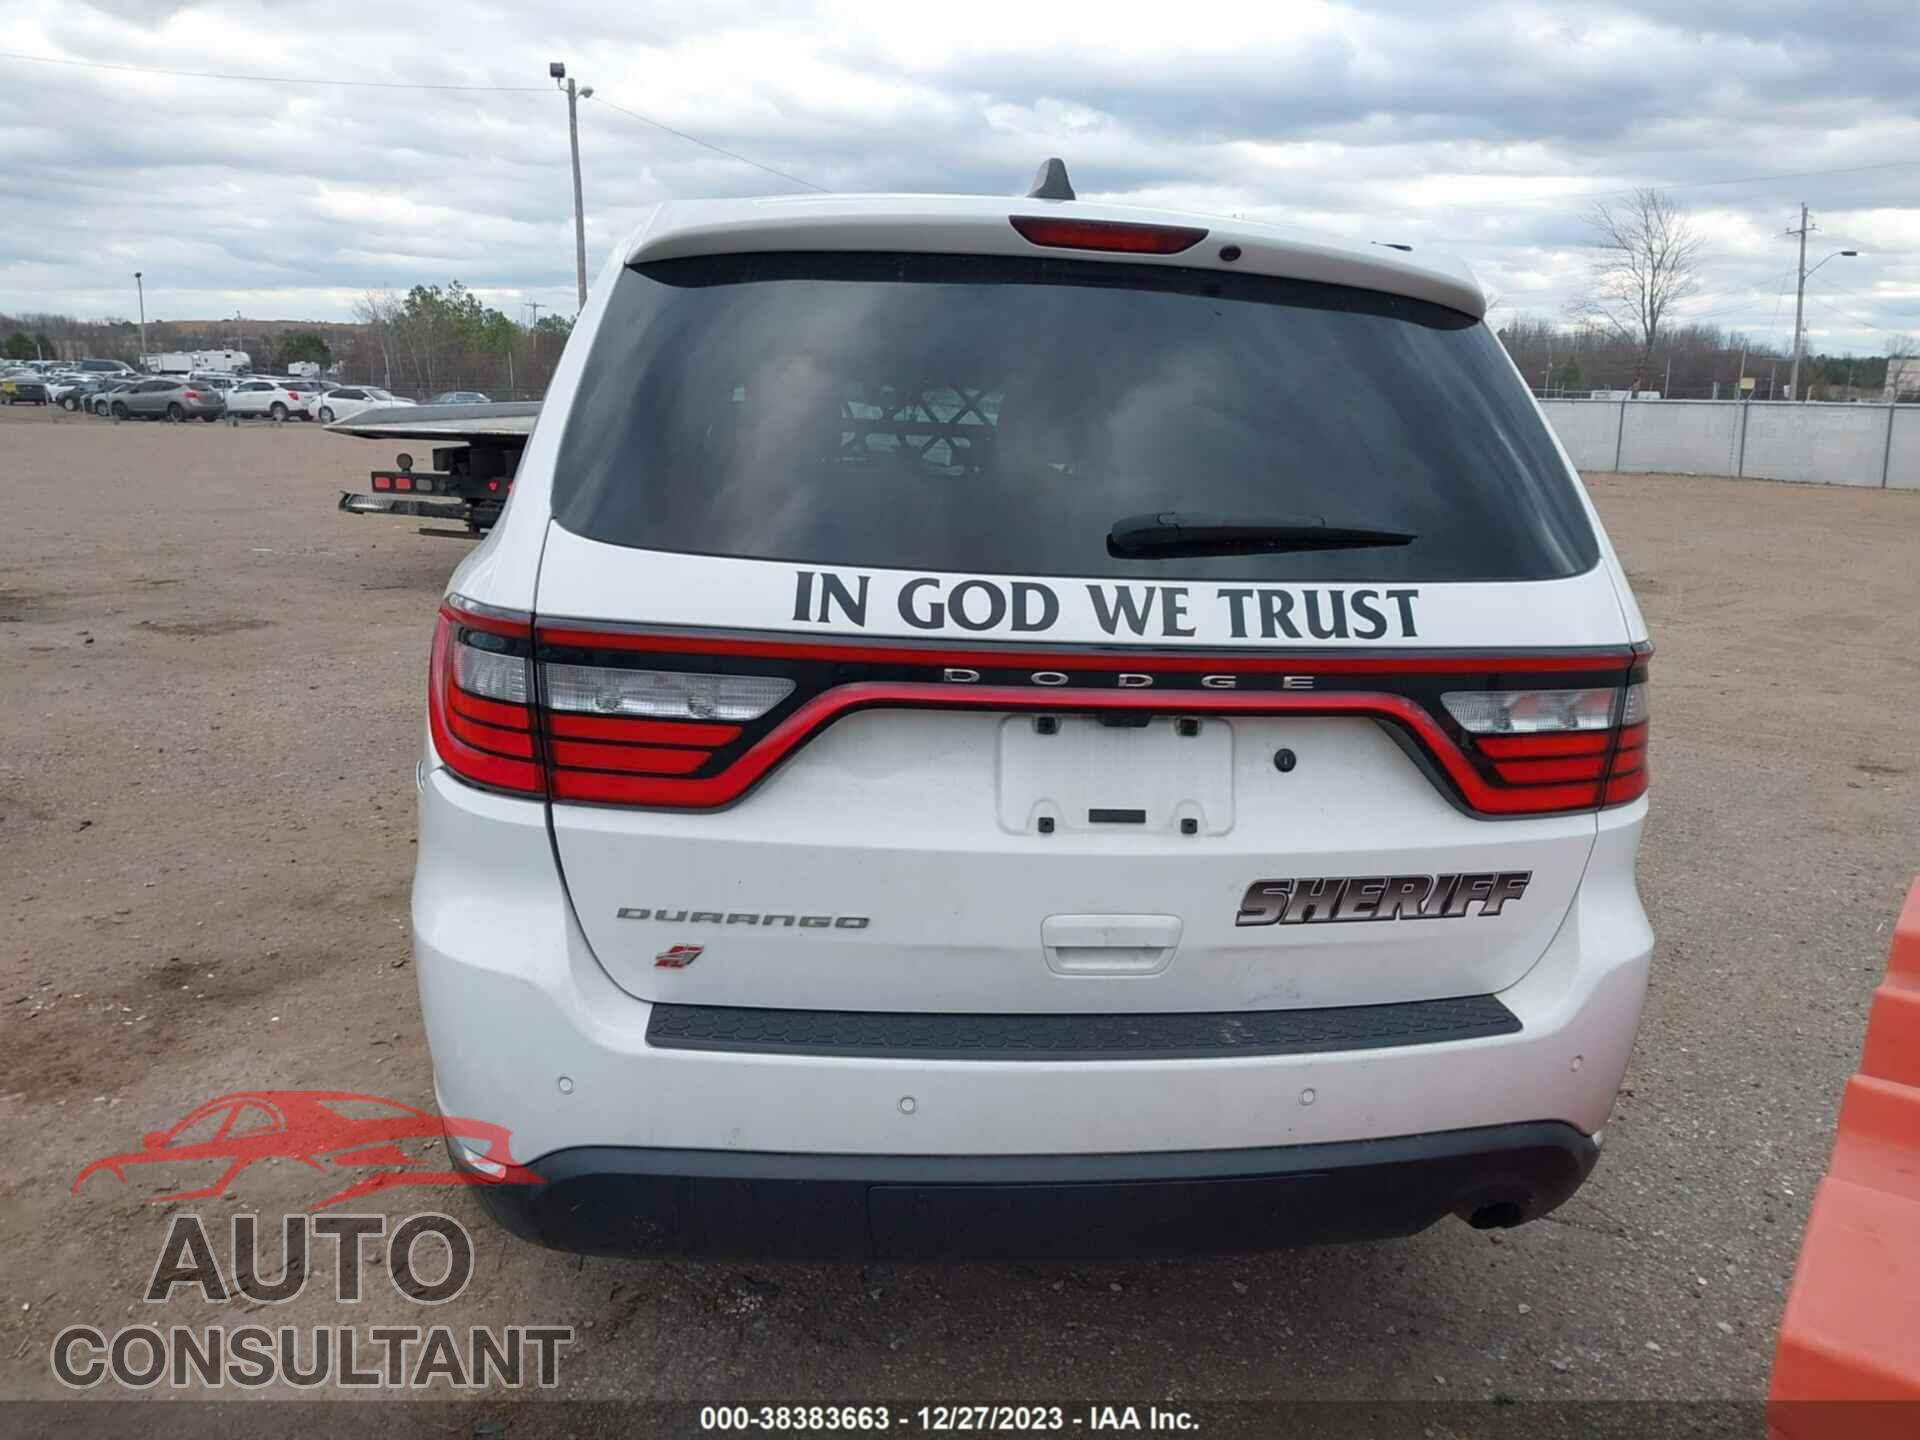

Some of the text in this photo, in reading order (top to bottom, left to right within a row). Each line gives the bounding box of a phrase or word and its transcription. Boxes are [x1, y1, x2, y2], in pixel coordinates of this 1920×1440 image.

[792, 571, 1419, 641] IN GOD WE TRUST
[942, 667, 1316, 690] DODGE
[616, 906, 870, 929] DURANGO
[1235, 870, 1533, 927] SHERIFF
